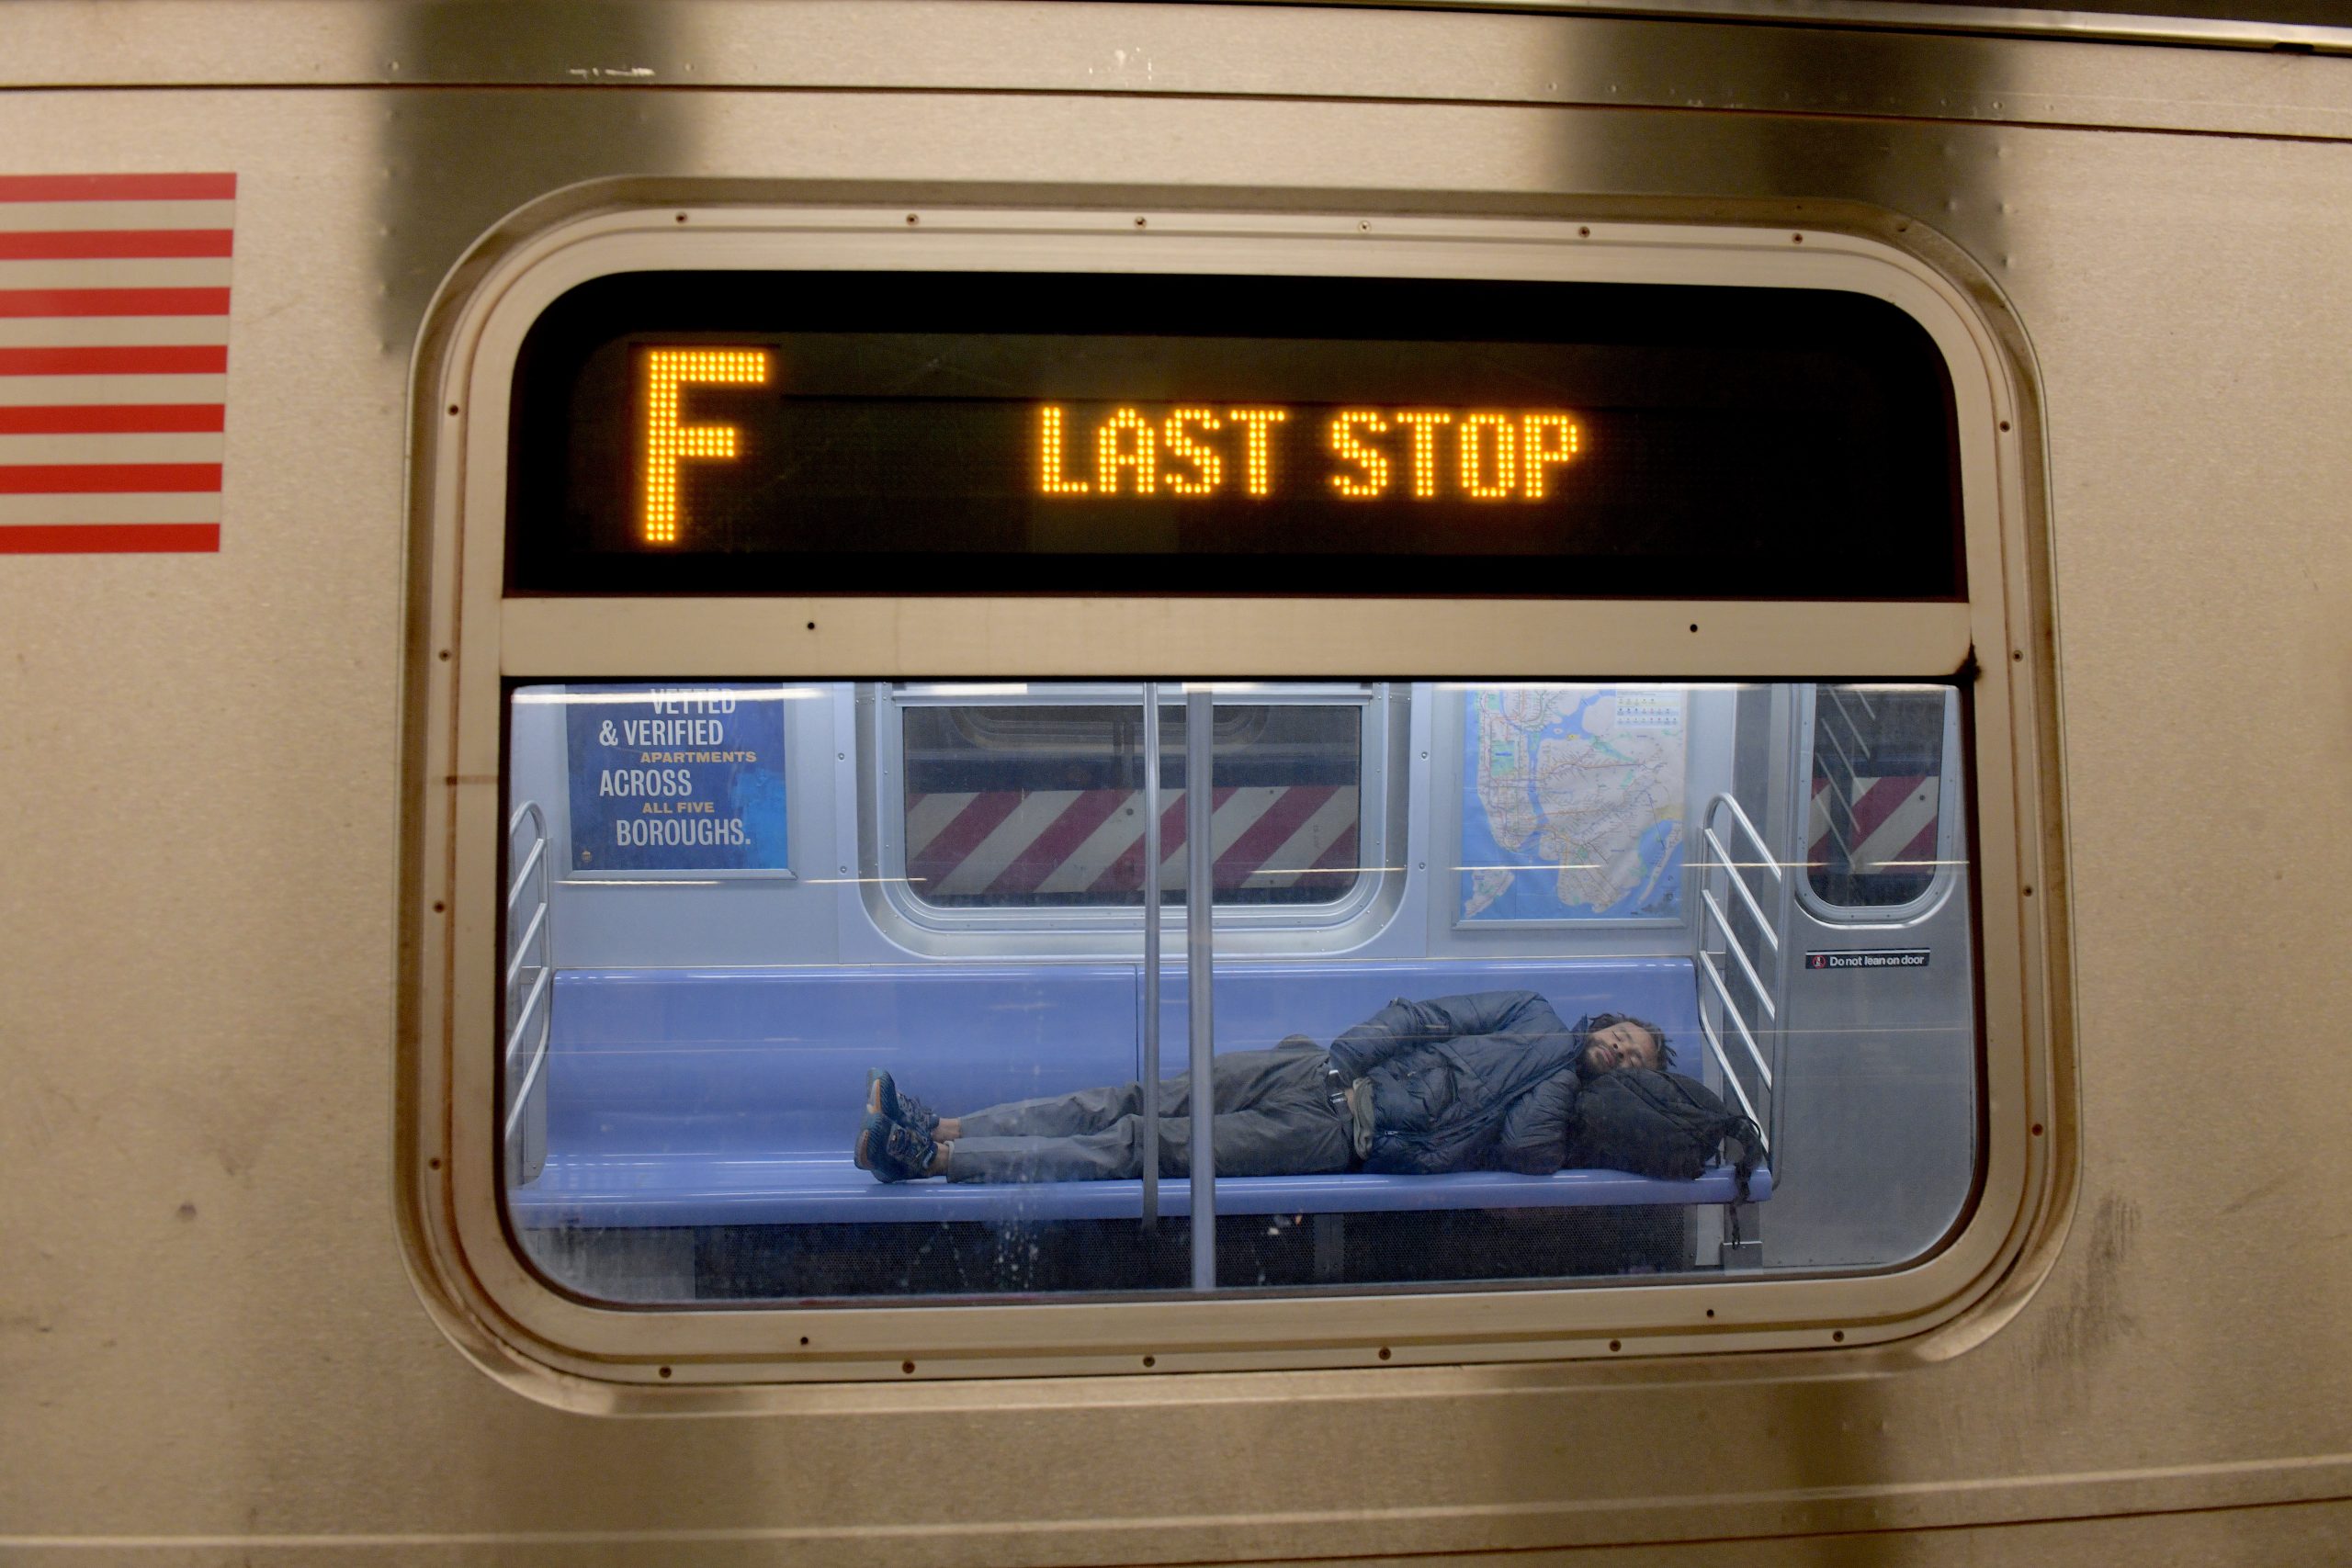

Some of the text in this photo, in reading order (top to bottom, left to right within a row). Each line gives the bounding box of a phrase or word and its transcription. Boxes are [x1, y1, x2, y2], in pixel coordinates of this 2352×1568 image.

[645, 351, 766, 542] F
[1040, 406, 1580, 499] LAST STOP
[650, 688, 736, 715] VETTED
[599, 719, 724, 746] & VERIFIED
[640, 750, 757, 763] APARTMENTS
[599, 769, 693, 796] ACROSS
[642, 802, 715, 814] ALL FIVE
[616, 818, 751, 846] BOROUGHS.
[1829, 954, 1924, 966] Do not lean on door
